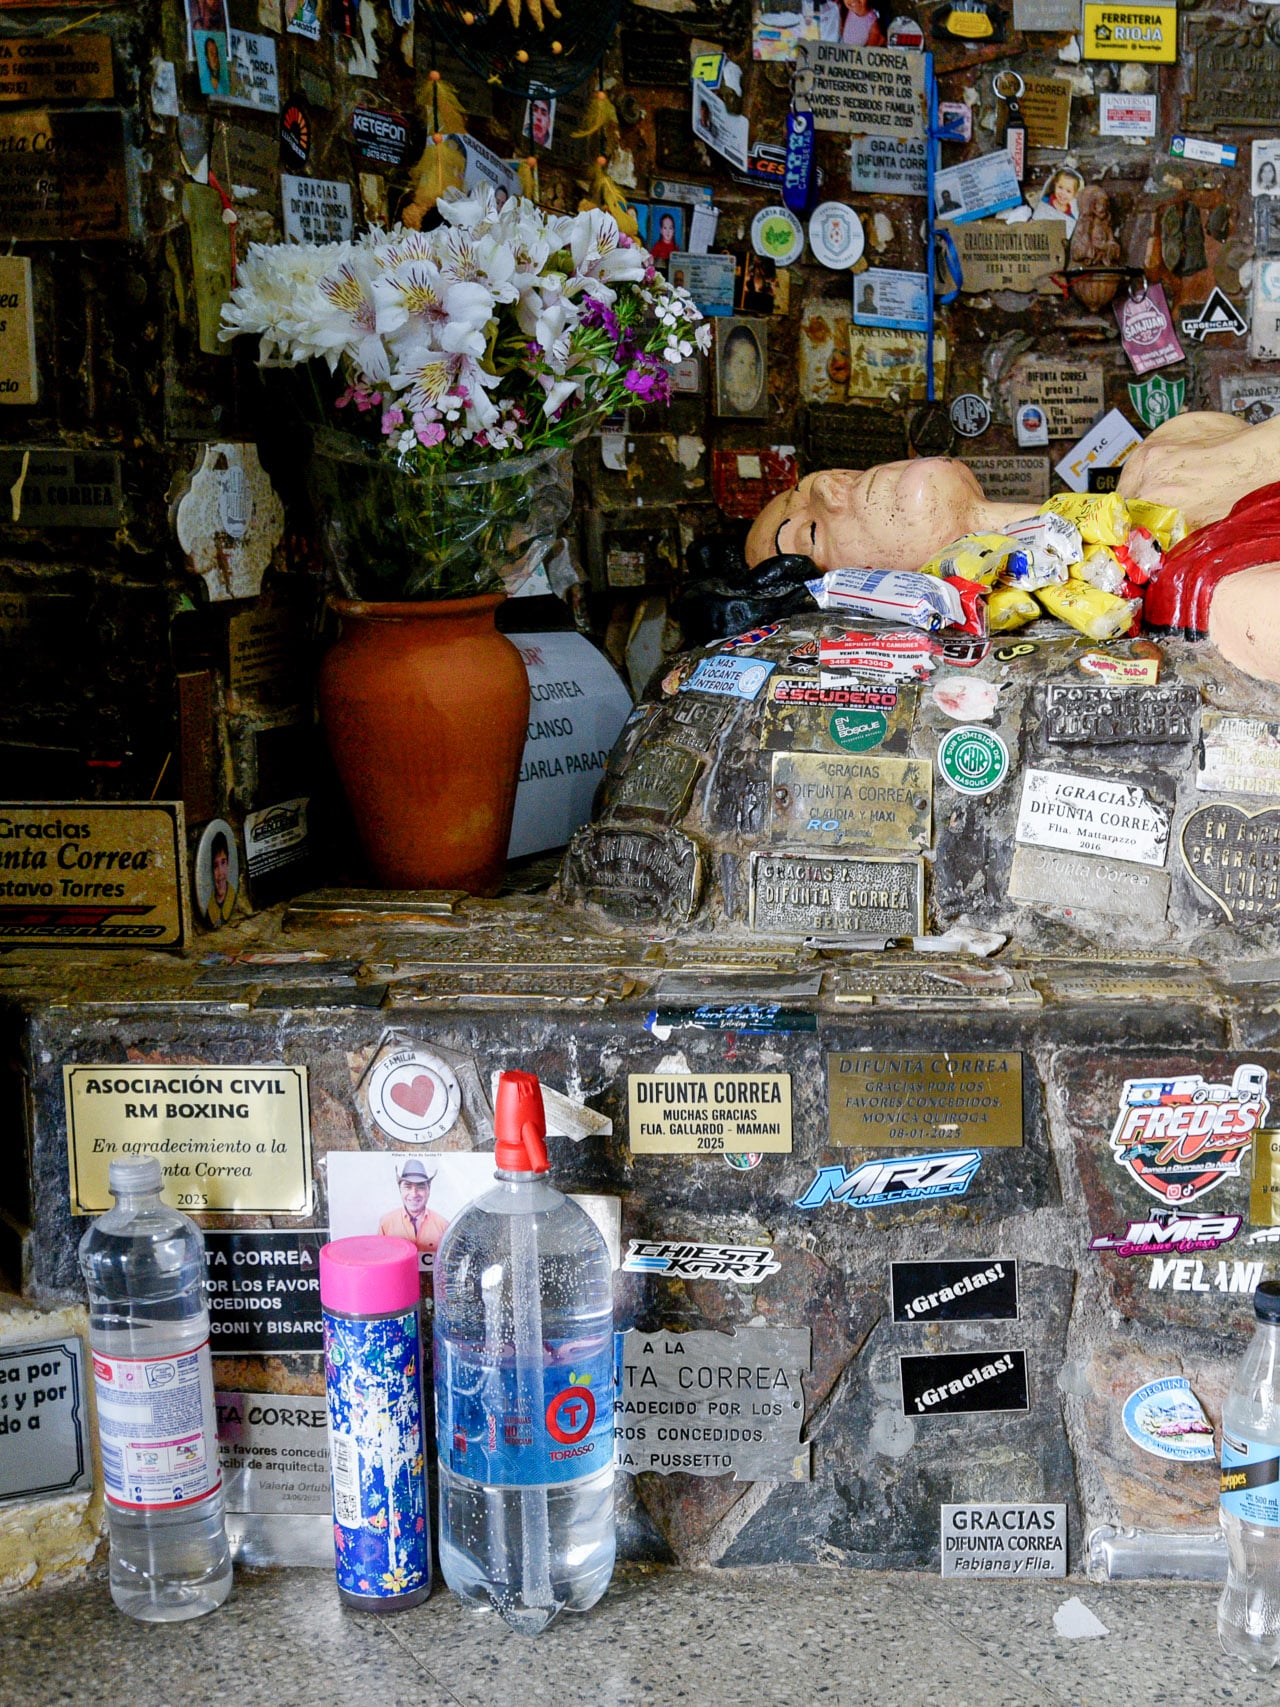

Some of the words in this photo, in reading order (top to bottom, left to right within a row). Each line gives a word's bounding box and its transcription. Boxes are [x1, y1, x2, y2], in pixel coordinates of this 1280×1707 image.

[1101, 13, 1162, 25] FERRETERIA
[1114, 26, 1163, 42] RIOJA
[817, 45, 863, 66] DIFUNTA
[867, 52, 908, 70] CORREA
[827, 65, 894, 83] AGRADECIMIENTO
[896, 74, 912, 86] POR
[879, 85, 895, 97] POR
[896, 87, 912, 99] LOS
[353, 113, 406, 141] KETEFON
[870, 139, 924, 155] GRACIAS
[857, 153, 897, 169] DIFUNTA
[298, 182, 338, 200] GRACIAS
[693, 678, 735, 693] INTERIOR
[775, 688, 898, 706] ESCUDERO
[828, 763, 880, 779] GRACIAS
[858, 785, 914, 801] CORREA
[870, 810, 896, 823] MAXI
[1030, 800, 1094, 823] DIFUNTA
[1100, 811, 1160, 833] CORREA
[1076, 828, 1138, 847] Mattarazzo
[1079, 841, 1101, 851] 2016
[57, 843, 151, 870] Correa
[59, 879, 125, 898] Torres
[766, 886, 832, 906] DIFUNTA
[850, 889, 910, 910] CORREA
[839, 1058, 926, 1075] DIFUNTA
[931, 1057, 1010, 1075] CORREA
[86, 1074, 224, 1095] ASOCIACIÓN
[230, 1079, 286, 1095] CIVIL
[636, 1081, 709, 1104] DIFUNTA
[713, 1081, 782, 1104] CORREA
[865, 1081, 922, 1094] GRACIAS
[926, 1081, 955, 1094] POR
[958, 1080, 985, 1093] LOS
[125, 1103, 159, 1119] RM
[166, 1103, 250, 1119] BOXING
[663, 1109, 709, 1121] MUCHAS
[711, 1109, 757, 1122] GRACIAS
[640, 1123, 666, 1136] FLIA.
[669, 1123, 724, 1136] GALLARDO
[736, 1123, 781, 1136] MAMANI
[1121, 1102, 1263, 1140] FREDES
[91, 1138, 118, 1154] En
[121, 1139, 252, 1156] agradecimiento
[255, 1141, 267, 1154] a
[270, 1138, 288, 1154] la
[696, 1137, 725, 1150] 2025
[195, 1161, 253, 1178] Correa
[177, 1193, 210, 1206] 2025
[232, 1250, 313, 1266] CORREA
[631, 1242, 770, 1263] CHIESA
[232, 1280, 263, 1292] LOS
[904, 1262, 1006, 1319] ¡Gracias!
[642, 1341, 655, 1355] A
[665, 1341, 686, 1355] LA
[27, 1361, 61, 1383] por
[678, 1366, 790, 1390] CORREA
[914, 1353, 1015, 1412] ¡Gracias!
[33, 1384, 68, 1408] por
[708, 1401, 741, 1416] POR
[752, 1402, 784, 1416] LOS
[228, 1444, 278, 1456] favores
[550, 1442, 596, 1461] TORASSO
[247, 1457, 263, 1470] de
[650, 1453, 733, 1468] PUSSETTO
[952, 1509, 1056, 1531] GRACIAS
[945, 1535, 1005, 1552] DIFUNTA
[1007, 1535, 1063, 1552] CORREA
[954, 1556, 1012, 1571] Fabiana
